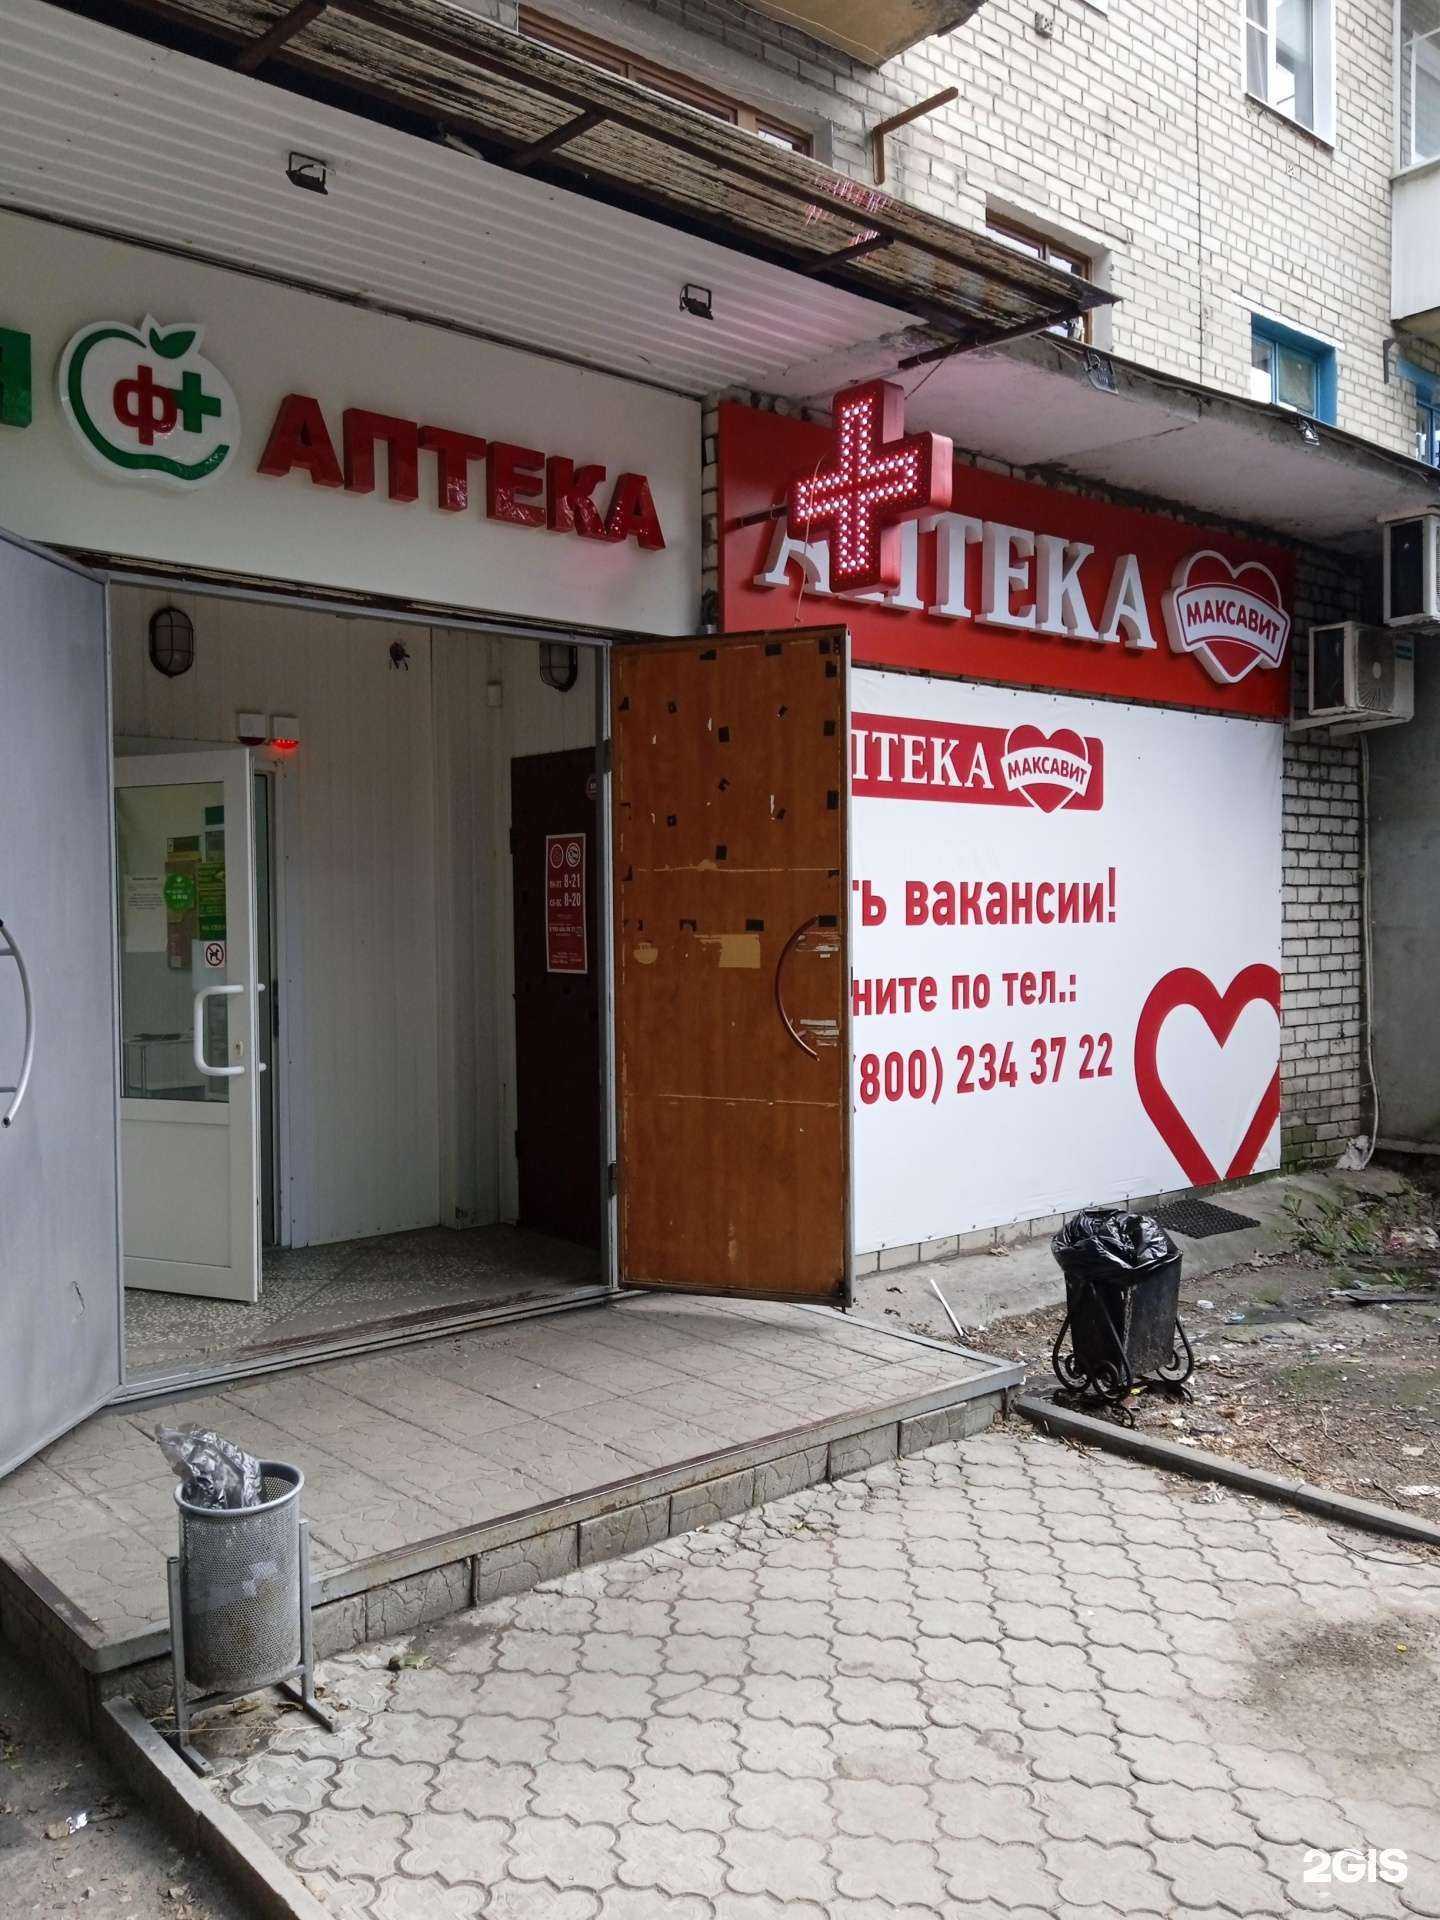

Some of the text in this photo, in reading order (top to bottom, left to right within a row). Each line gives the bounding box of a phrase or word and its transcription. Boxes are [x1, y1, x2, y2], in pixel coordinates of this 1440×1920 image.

[257, 393, 666, 551] АПТЕКА
[1186, 599, 1280, 644] МАКСАВИТ
[1007, 756, 1088, 785] МАКСАВИТ
[905, 867, 1116, 926] вакансии!
[952, 973, 991, 1010] по
[1002, 971, 1076, 1006] тел.:
[853, 1032, 1113, 1113] 800) 234 37 22
